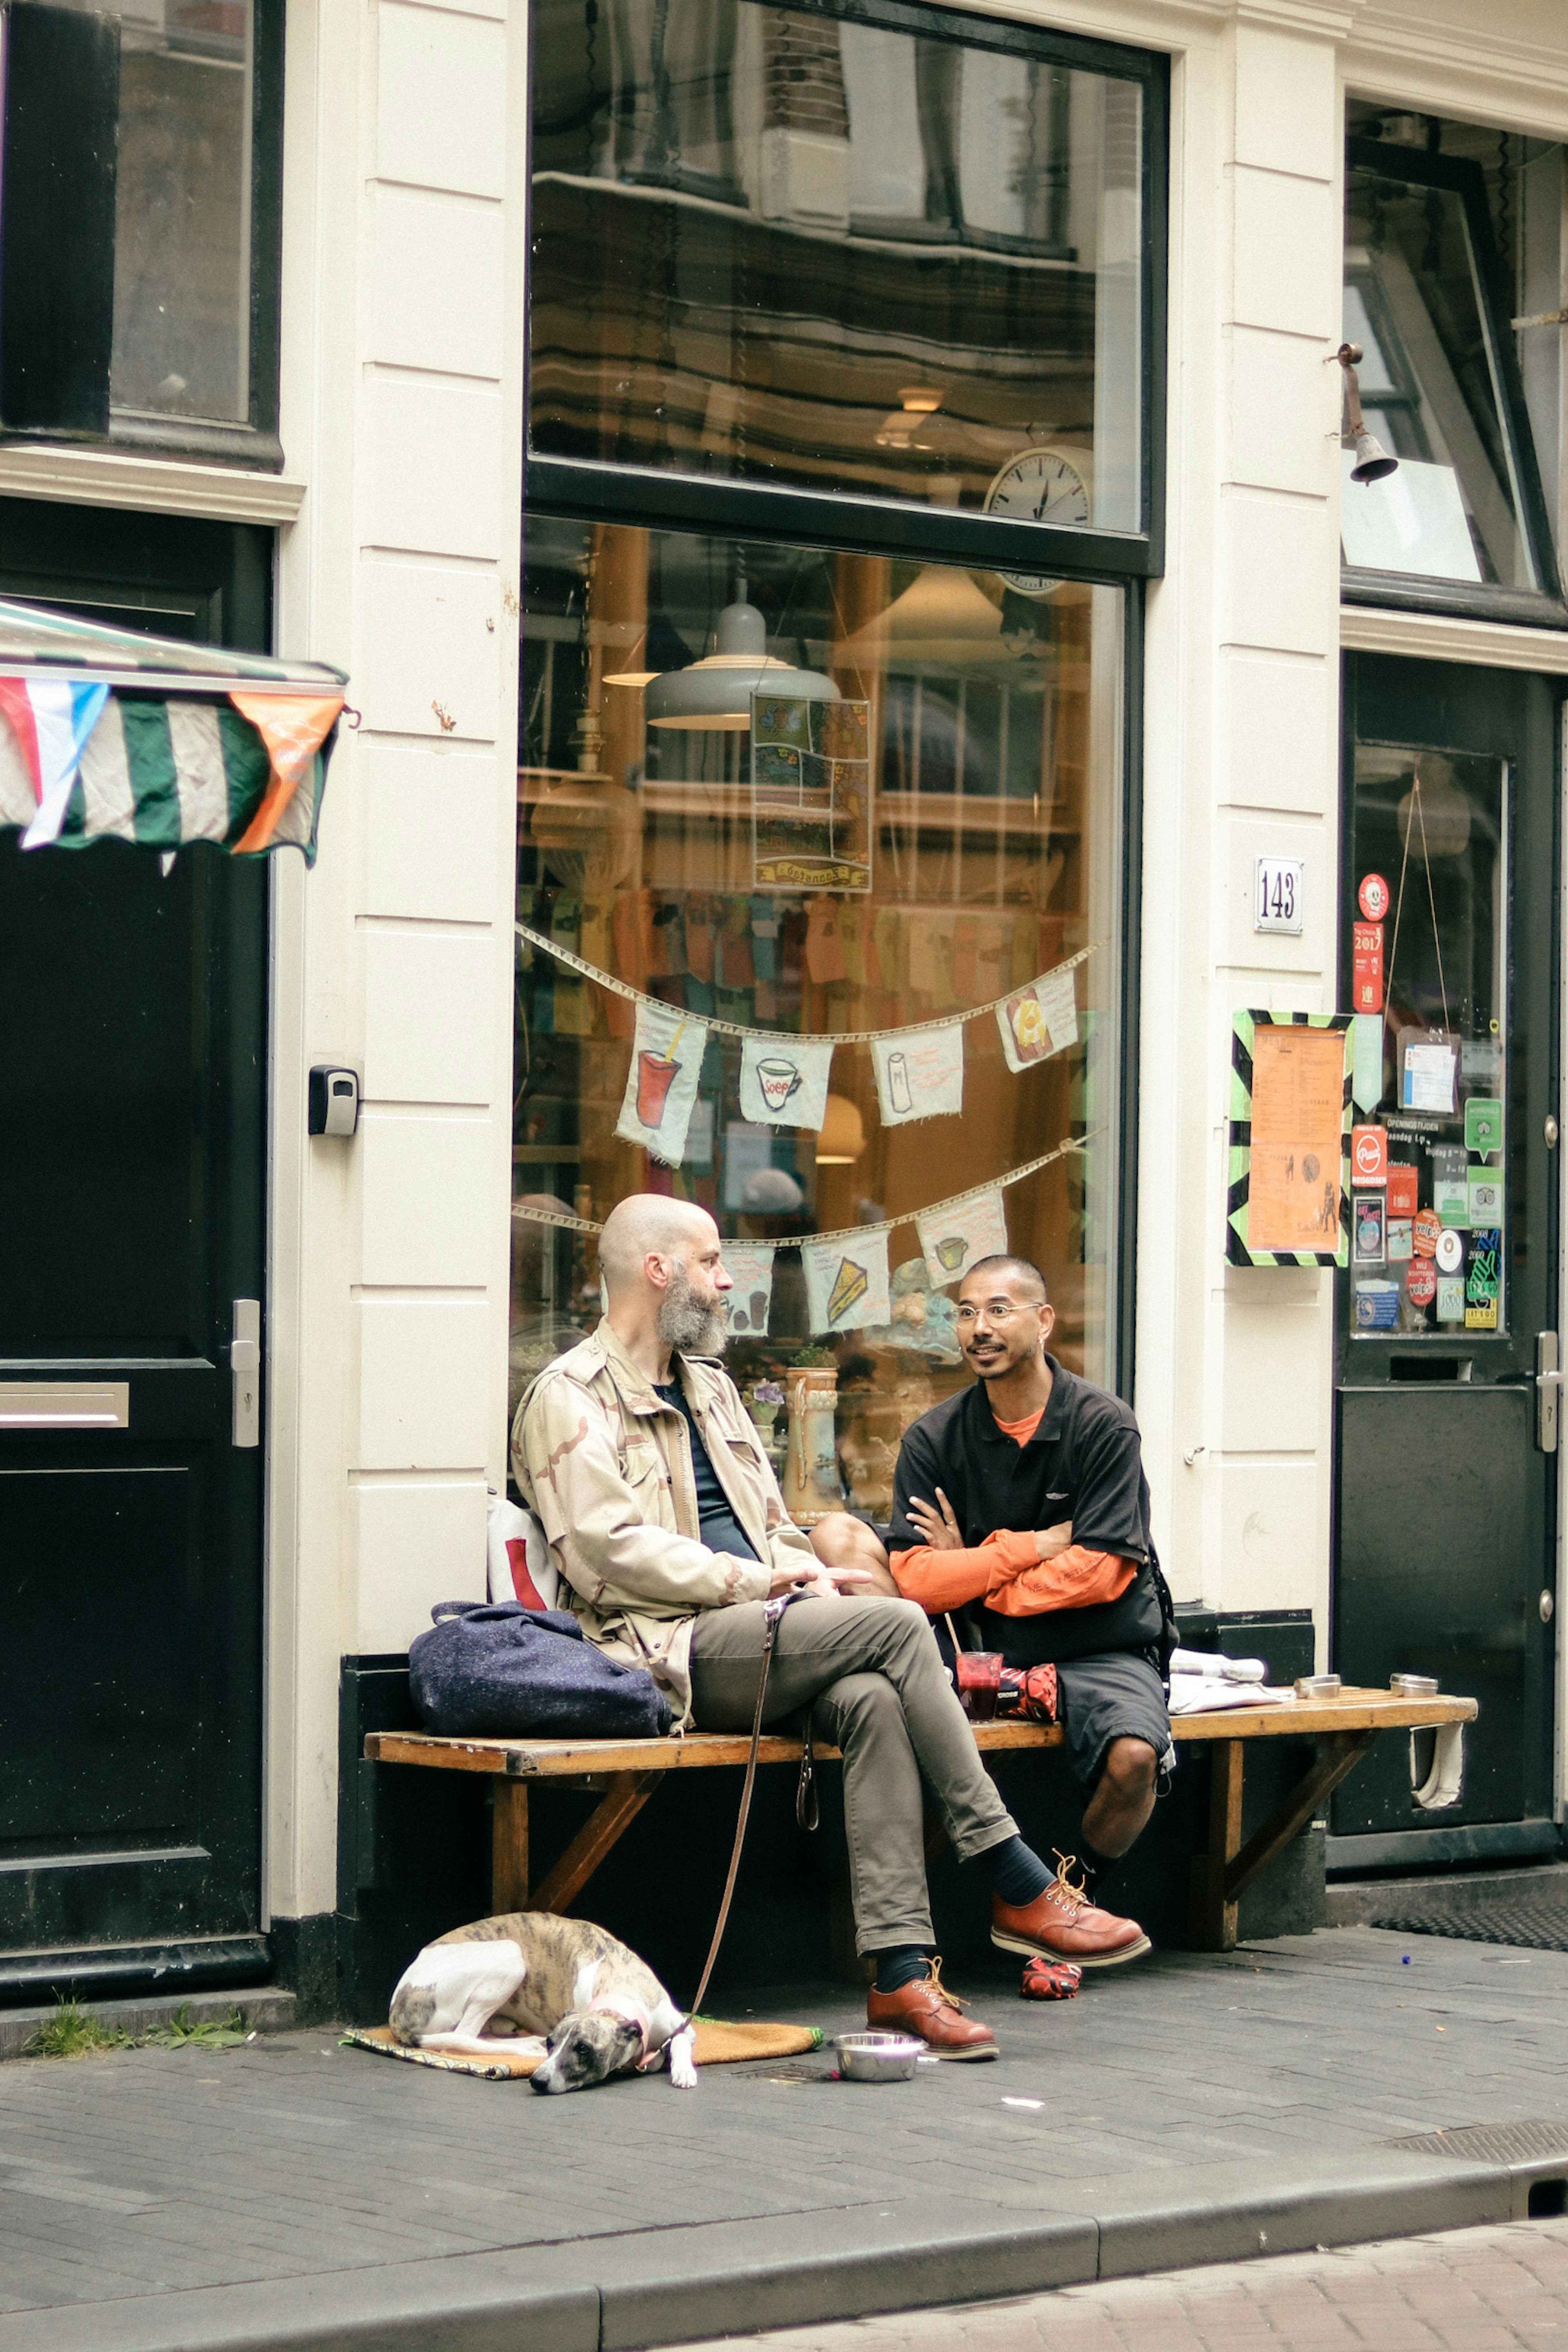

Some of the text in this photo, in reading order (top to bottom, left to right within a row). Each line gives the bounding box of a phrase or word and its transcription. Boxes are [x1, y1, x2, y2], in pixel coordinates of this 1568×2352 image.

[1262, 871, 1294, 919] 143
[1354, 936, 1381, 951] 2017
[765, 1079, 788, 1095] Soep
[1358, 1205, 1368, 1216] GET
[1417, 1224, 1432, 1236] yelp
[1410, 1282, 1426, 1295] yelp
